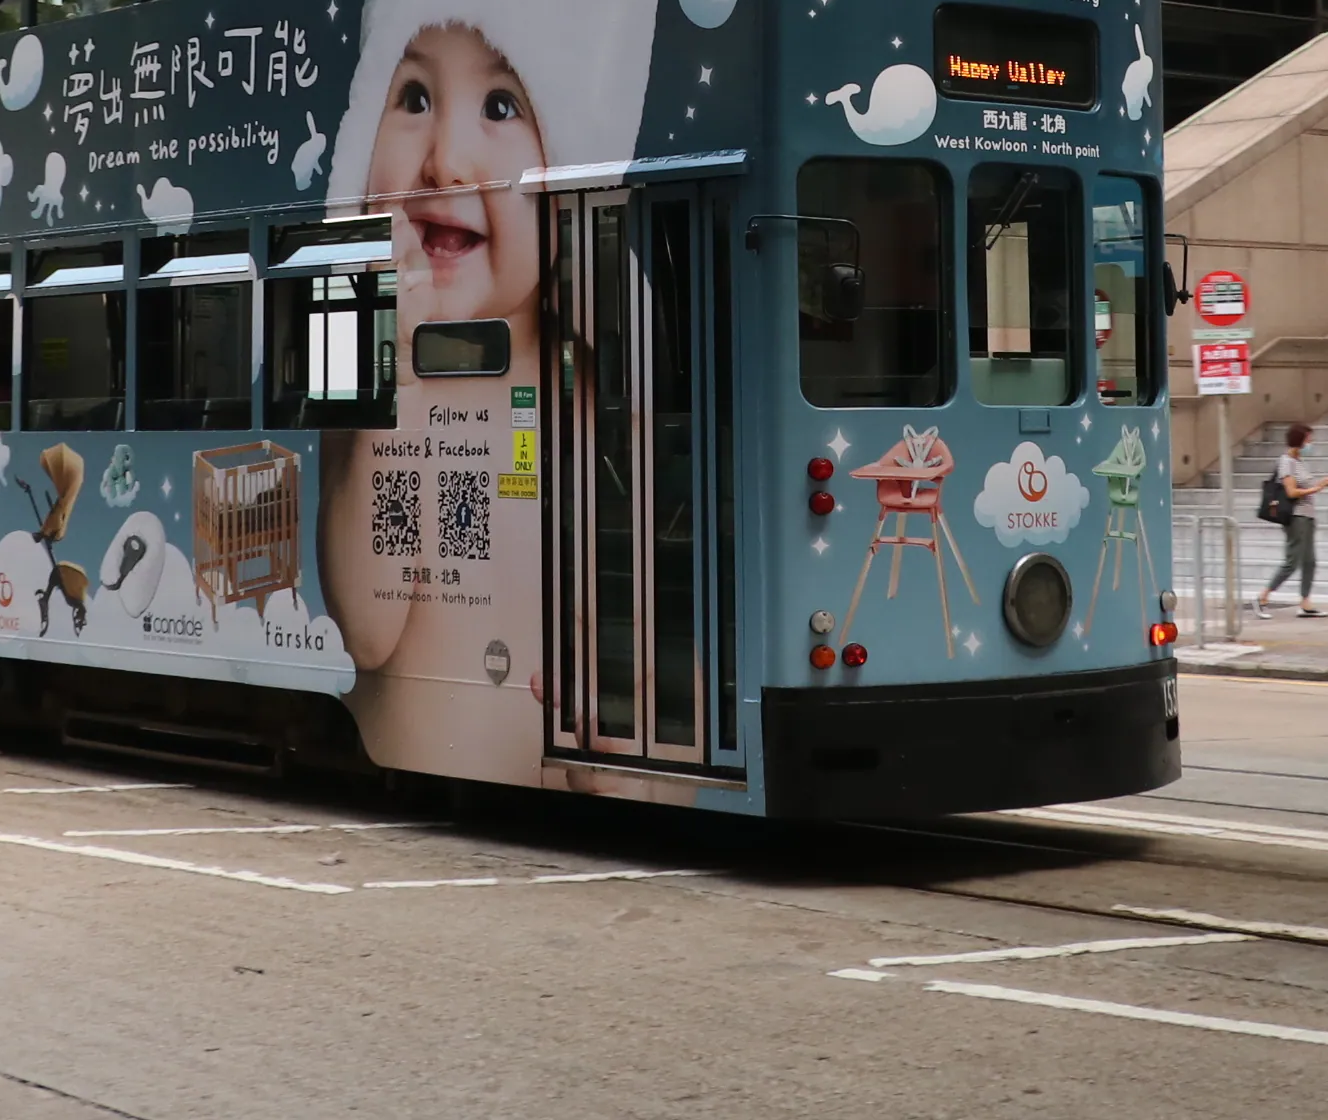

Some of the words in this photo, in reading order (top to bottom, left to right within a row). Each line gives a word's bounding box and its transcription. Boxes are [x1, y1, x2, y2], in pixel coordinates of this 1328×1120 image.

[949, 55, 1000, 81] Happy
[1007, 60, 1066, 86] Valley
[89, 150, 140, 173] Dream
[148, 139, 179, 162] the
[187, 120, 280, 167] possibility
[933, 133, 971, 150] West
[974, 136, 1028, 153] Kowloon
[1041, 140, 1073, 156] North
[1075, 143, 1100, 159] point
[429, 405, 469, 426] Follow
[476, 409, 489, 422] us
[372, 437, 421, 457] Website
[438, 438, 490, 458] Facebook
[520, 451, 528, 460] IN
[515, 461, 533, 471] ONLY
[1007, 511, 1058, 529] STOKKE
[373, 588, 394, 601] West
[396, 590, 432, 603] Kowloon
[441, 593, 466, 606] North
[468, 594, 491, 608] point
[153, 615, 204, 637] candide
[266, 621, 325, 651] färska
